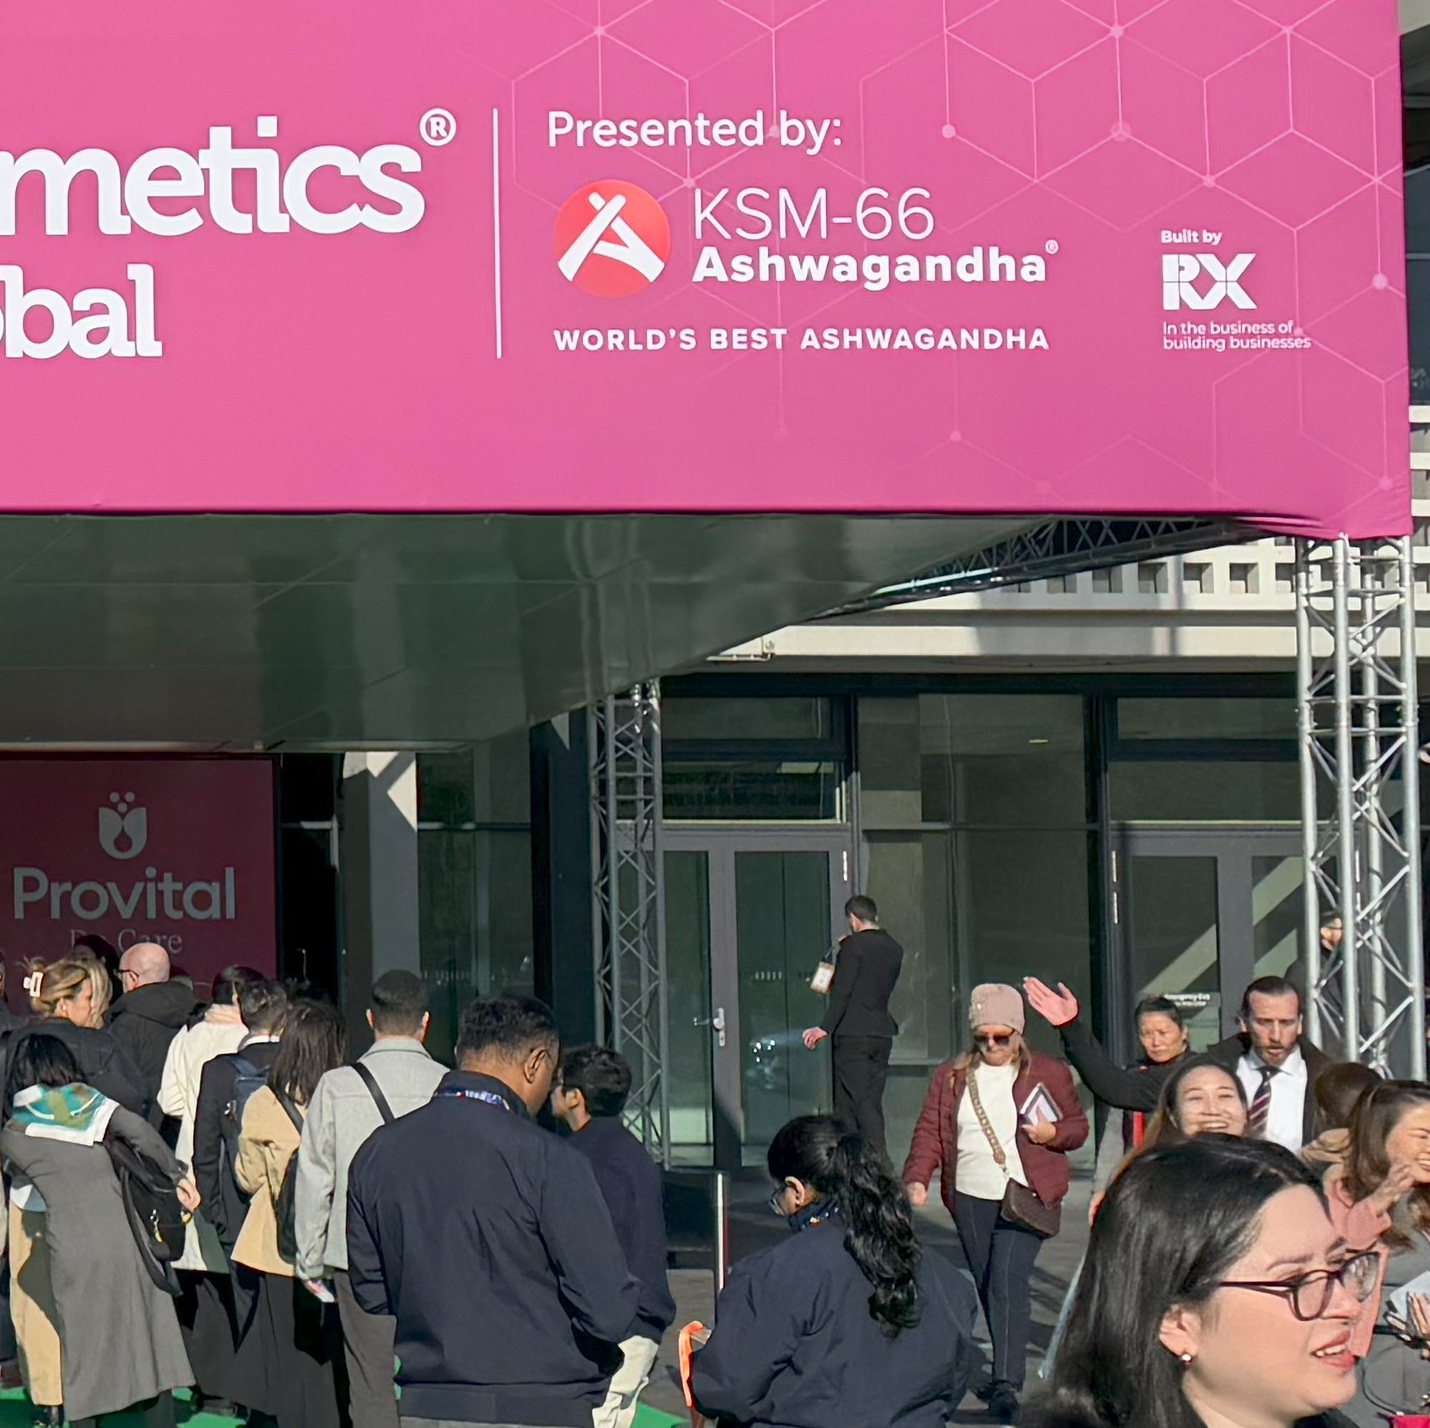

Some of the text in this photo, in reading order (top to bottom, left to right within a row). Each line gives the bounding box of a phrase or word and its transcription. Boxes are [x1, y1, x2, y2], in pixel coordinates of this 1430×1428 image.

[548, 110, 843, 156] Presented by:
[693, 187, 935, 241] KSM-66
[1161, 229, 1223, 246] Built by
[1162, 253, 1258, 311] RX
[553, 328, 1050, 352] WORLD'S BEST ASHWAGANDHA
[1163, 319, 1295, 336] In the business of
[1163, 335, 1312, 353] building businesses
[12, 866, 236, 921] Provital
